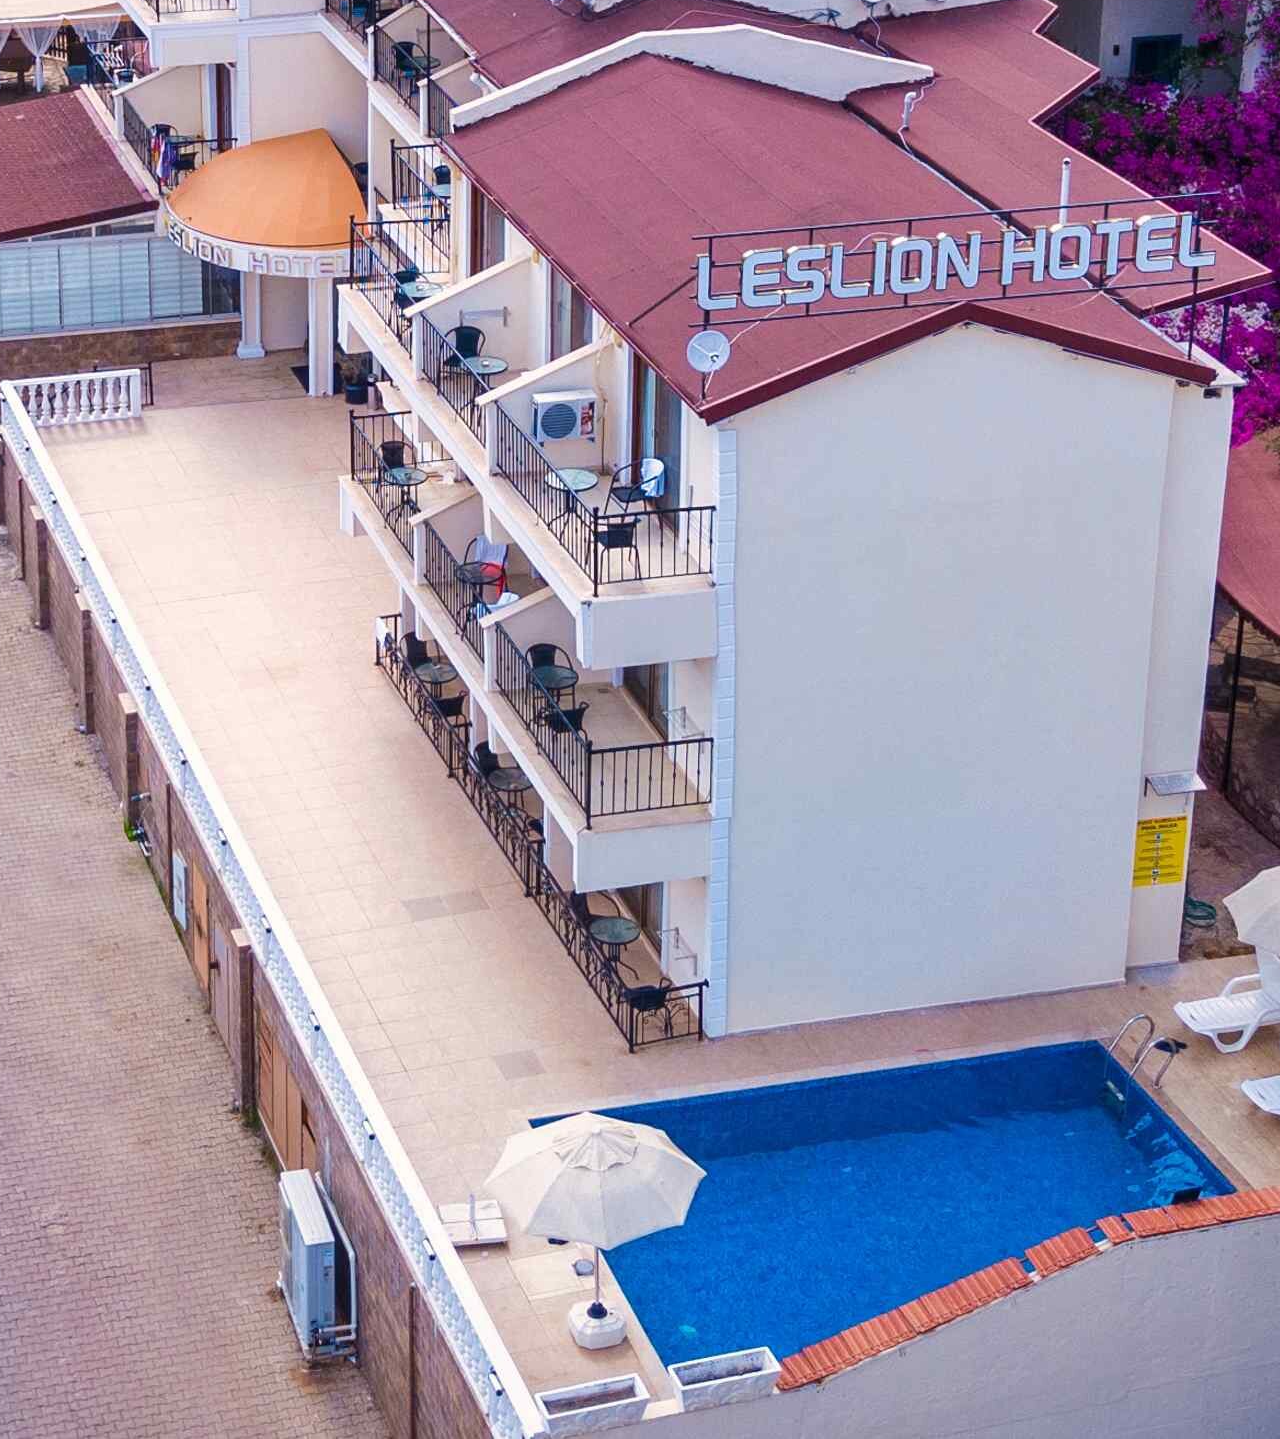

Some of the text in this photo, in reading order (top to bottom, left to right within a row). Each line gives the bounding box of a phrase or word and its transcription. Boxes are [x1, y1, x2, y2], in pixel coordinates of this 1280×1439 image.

[167, 220, 352, 277] ESLION HOTEL
[696, 211, 1216, 311] LESLION HOTEL
